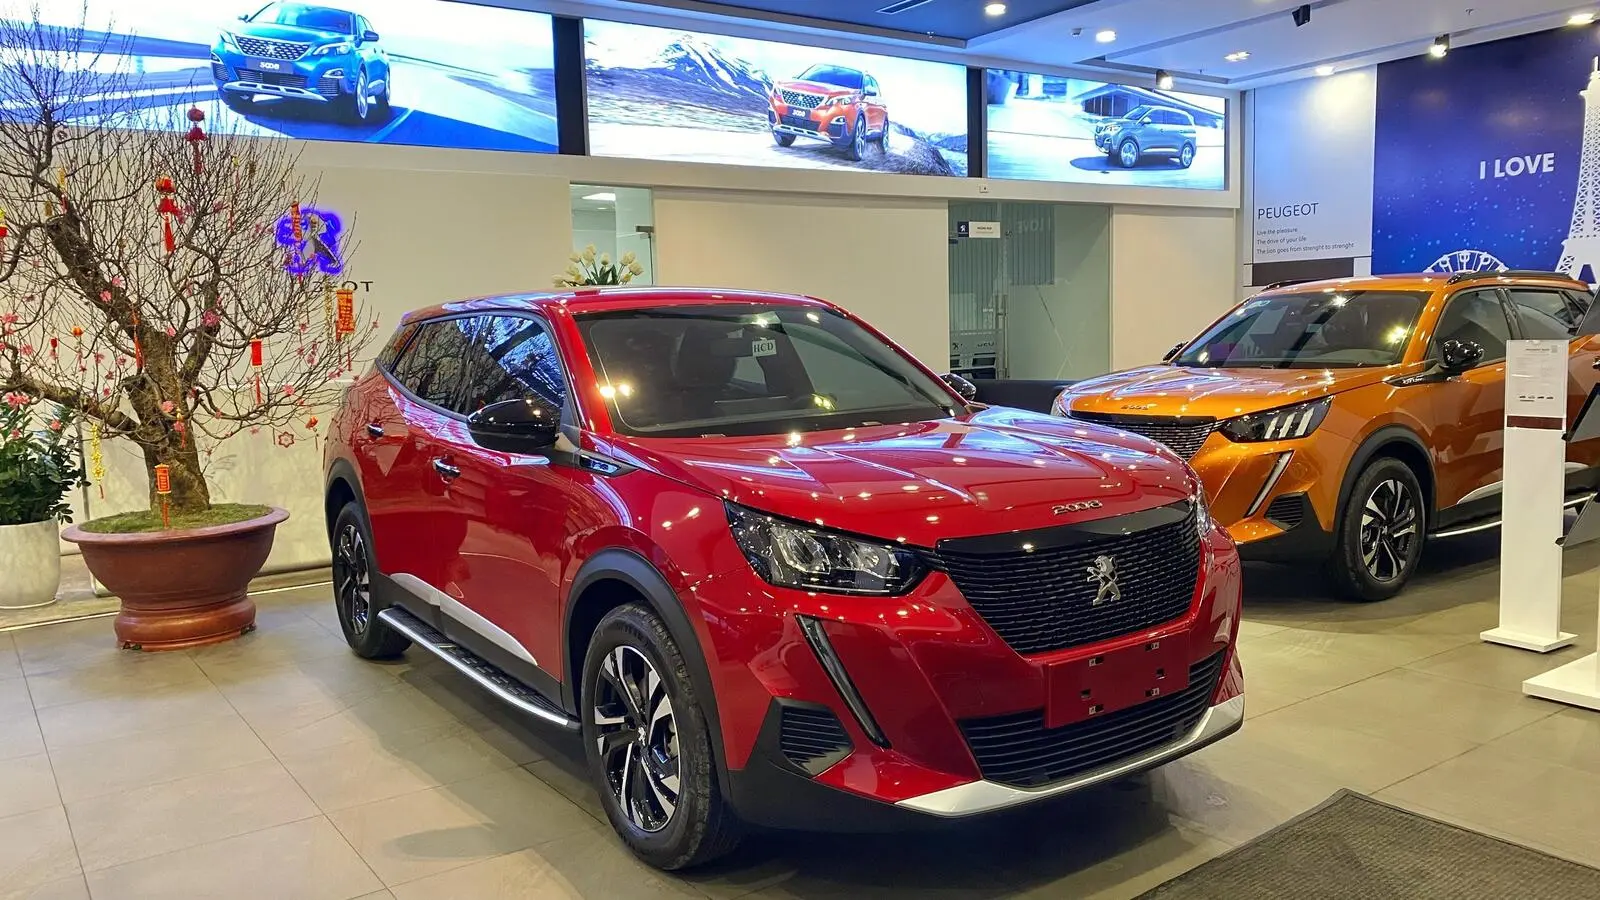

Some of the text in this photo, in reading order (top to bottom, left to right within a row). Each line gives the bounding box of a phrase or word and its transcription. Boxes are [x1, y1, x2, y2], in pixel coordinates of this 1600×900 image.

[1480, 152, 1555, 180] I LOVE
[1258, 203, 1319, 219] PEUGEOT
[1277, 227, 1298, 235] pleasure
[1277, 246, 1289, 254] goes
[753, 342, 774, 353] HCD
[1051, 499, 1103, 516] 2008
